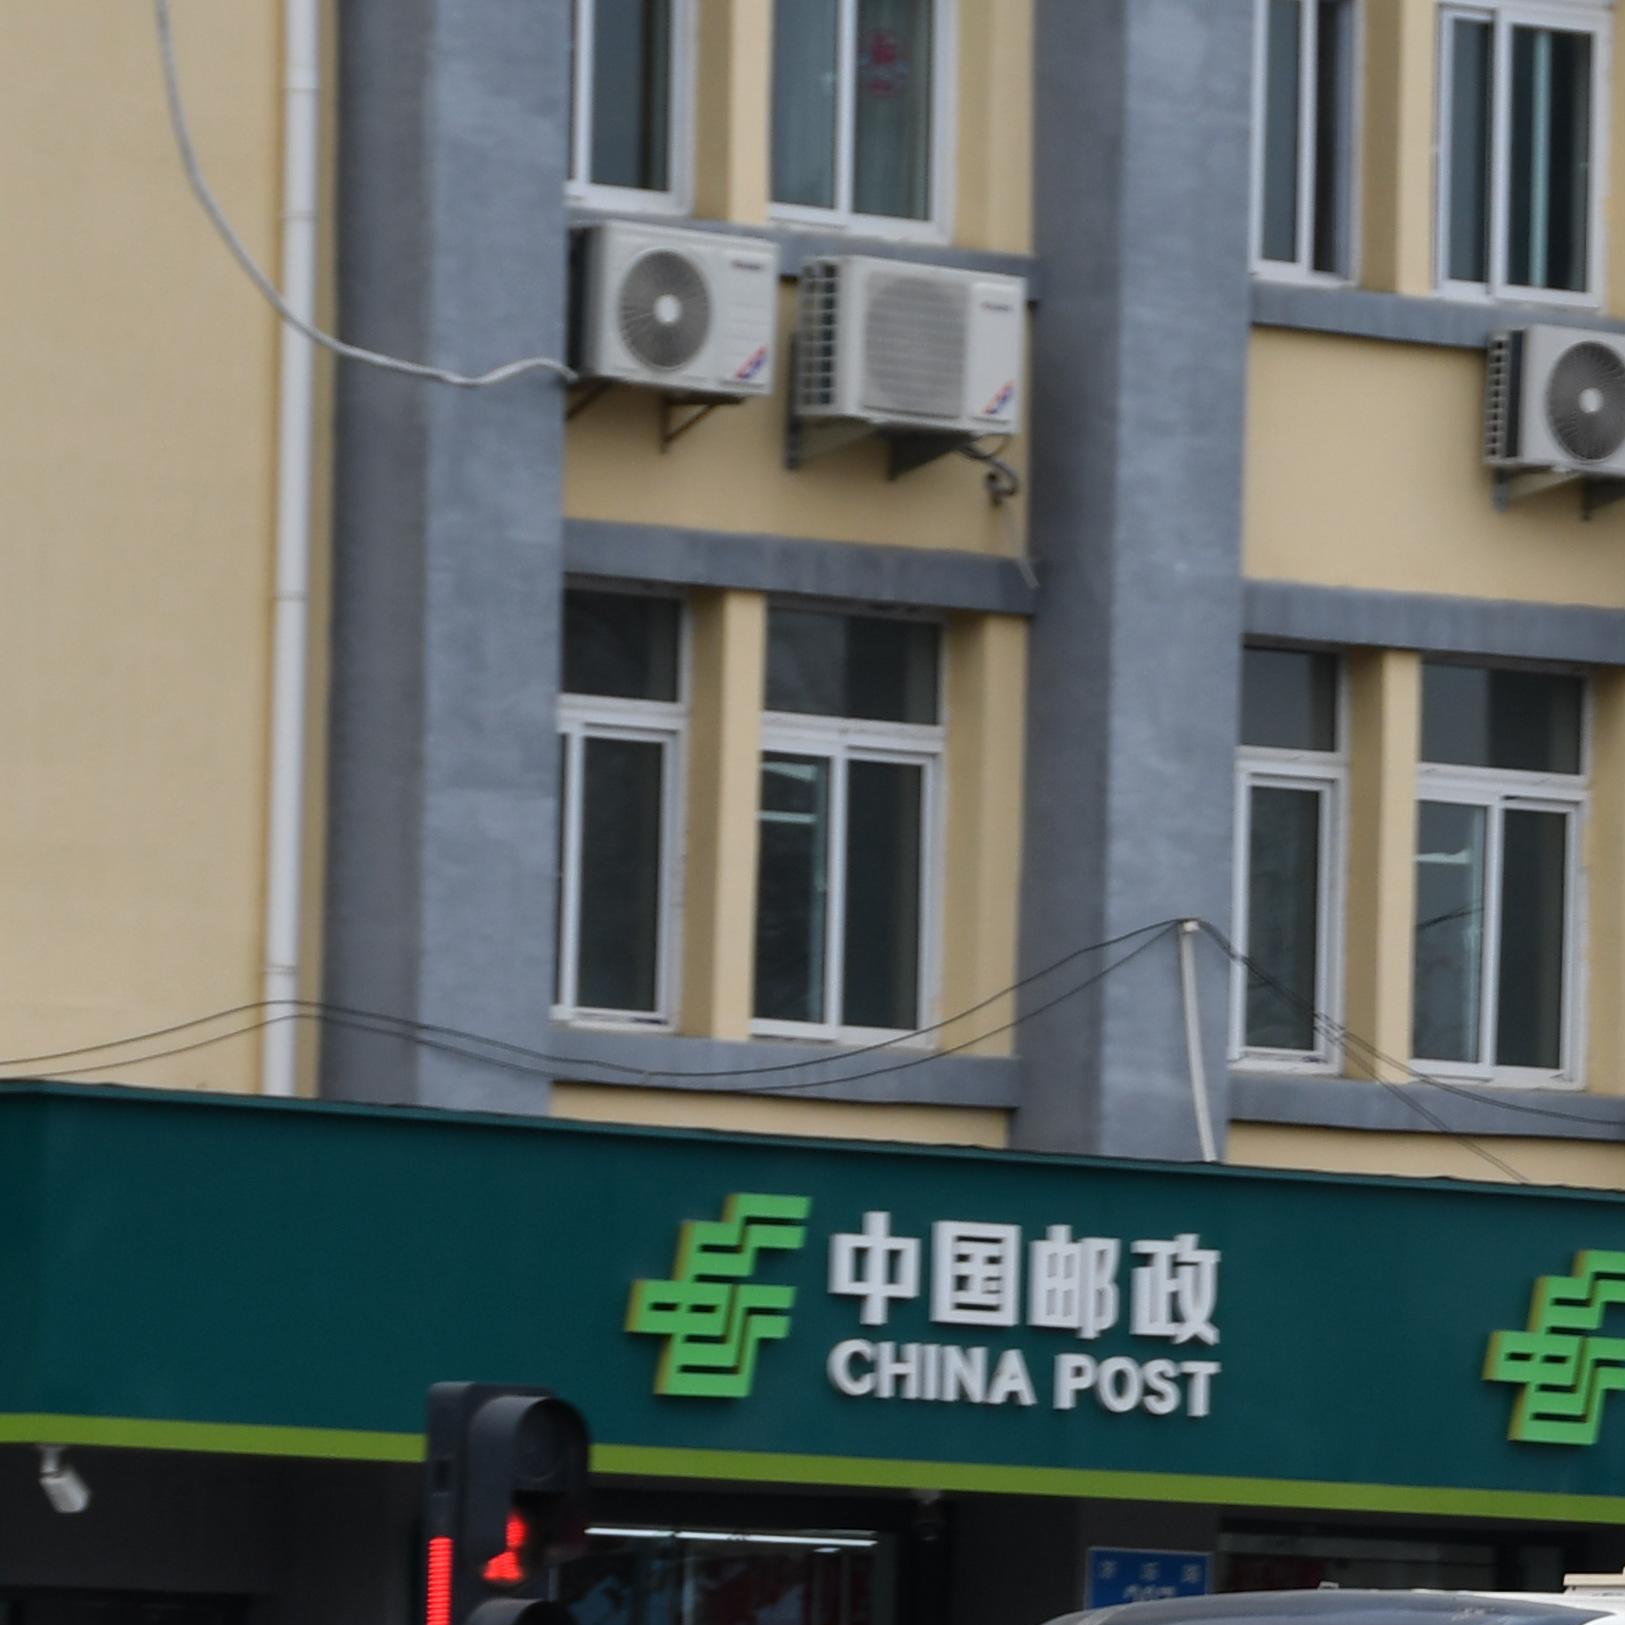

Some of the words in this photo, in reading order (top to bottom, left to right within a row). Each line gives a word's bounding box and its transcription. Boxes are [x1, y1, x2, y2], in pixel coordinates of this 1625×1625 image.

[828, 1211, 1221, 1344] 中国邮政
[828, 1339, 1037, 1406] CHINA
[1053, 1352, 1221, 1417] POST
